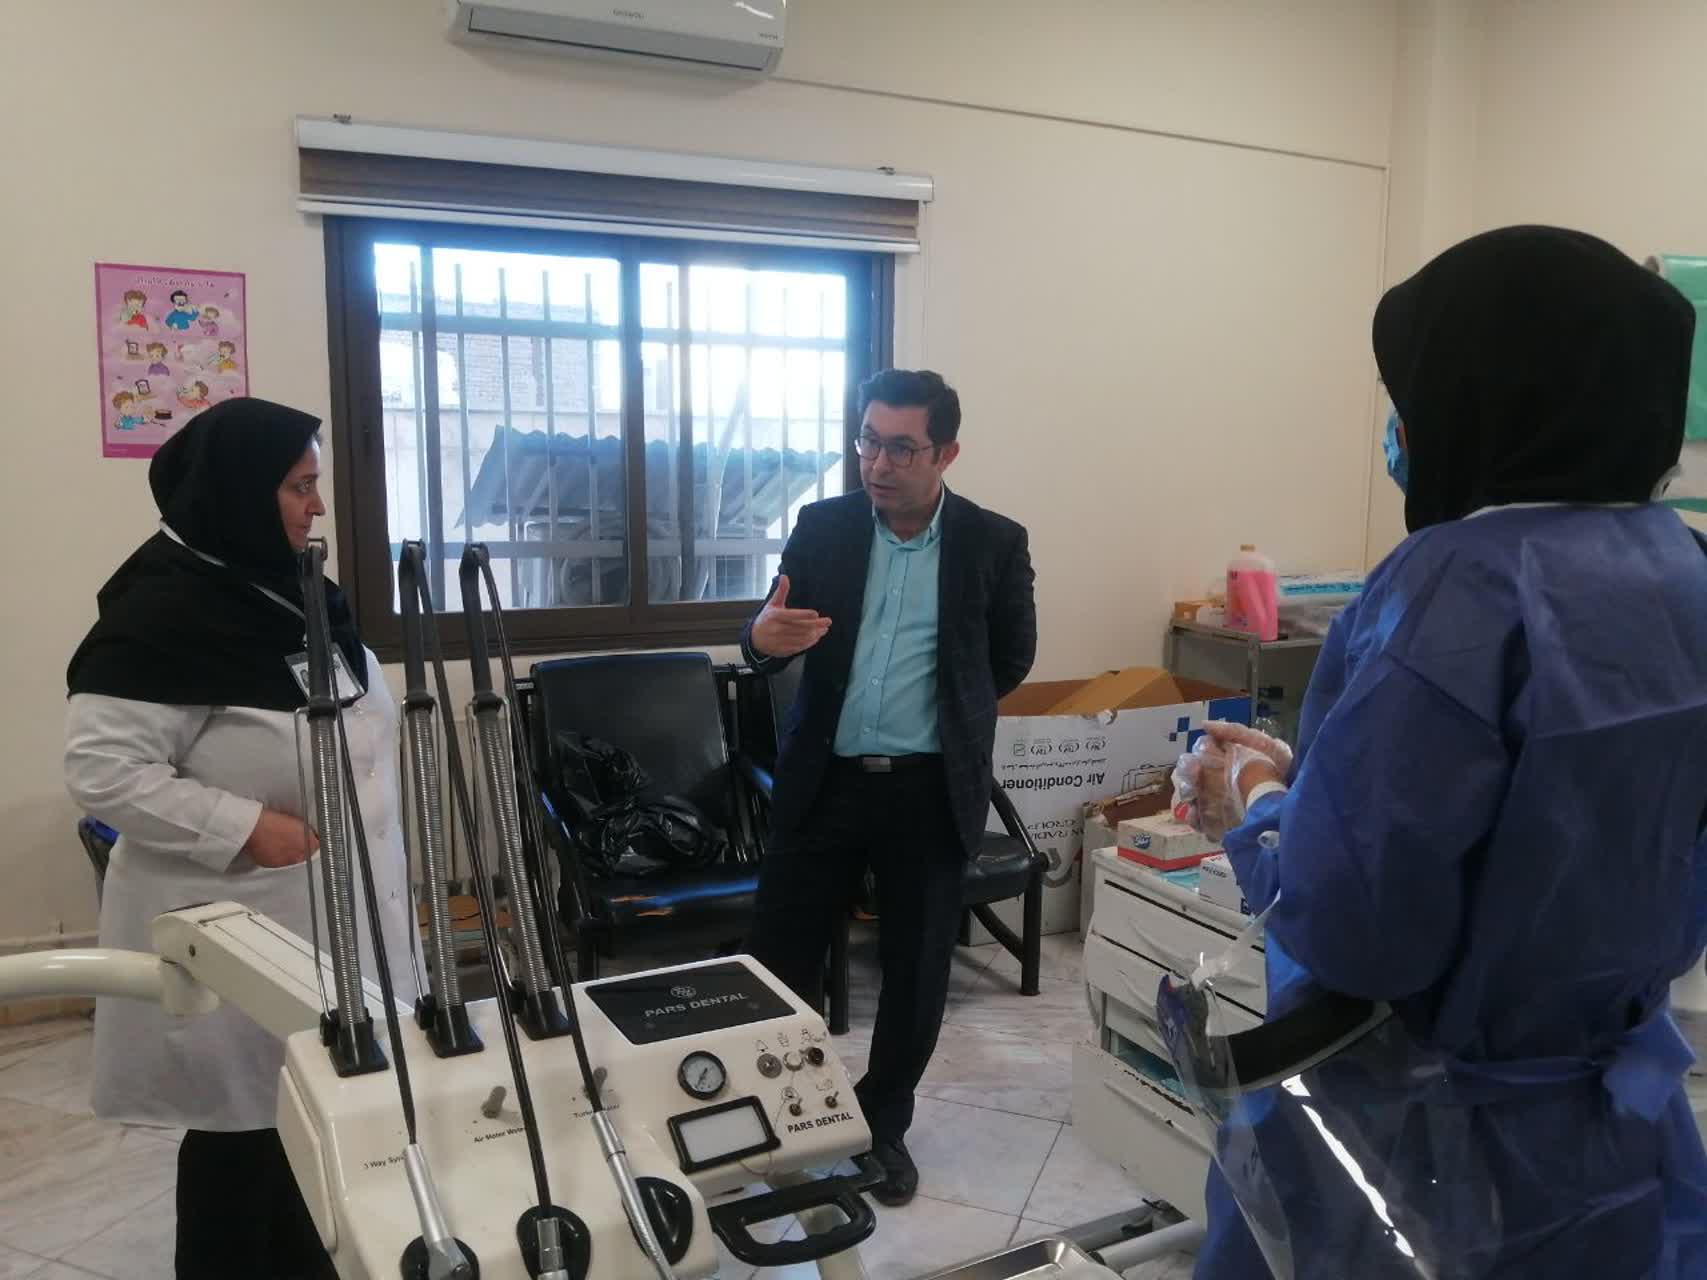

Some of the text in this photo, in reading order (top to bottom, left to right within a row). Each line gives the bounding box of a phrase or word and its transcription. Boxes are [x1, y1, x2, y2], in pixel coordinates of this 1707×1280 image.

[1000, 772, 1105, 791] Air Conditioner
[644, 992, 748, 1017] PARS DENTAL
[787, 1112, 854, 1133] PARS DENTAL
